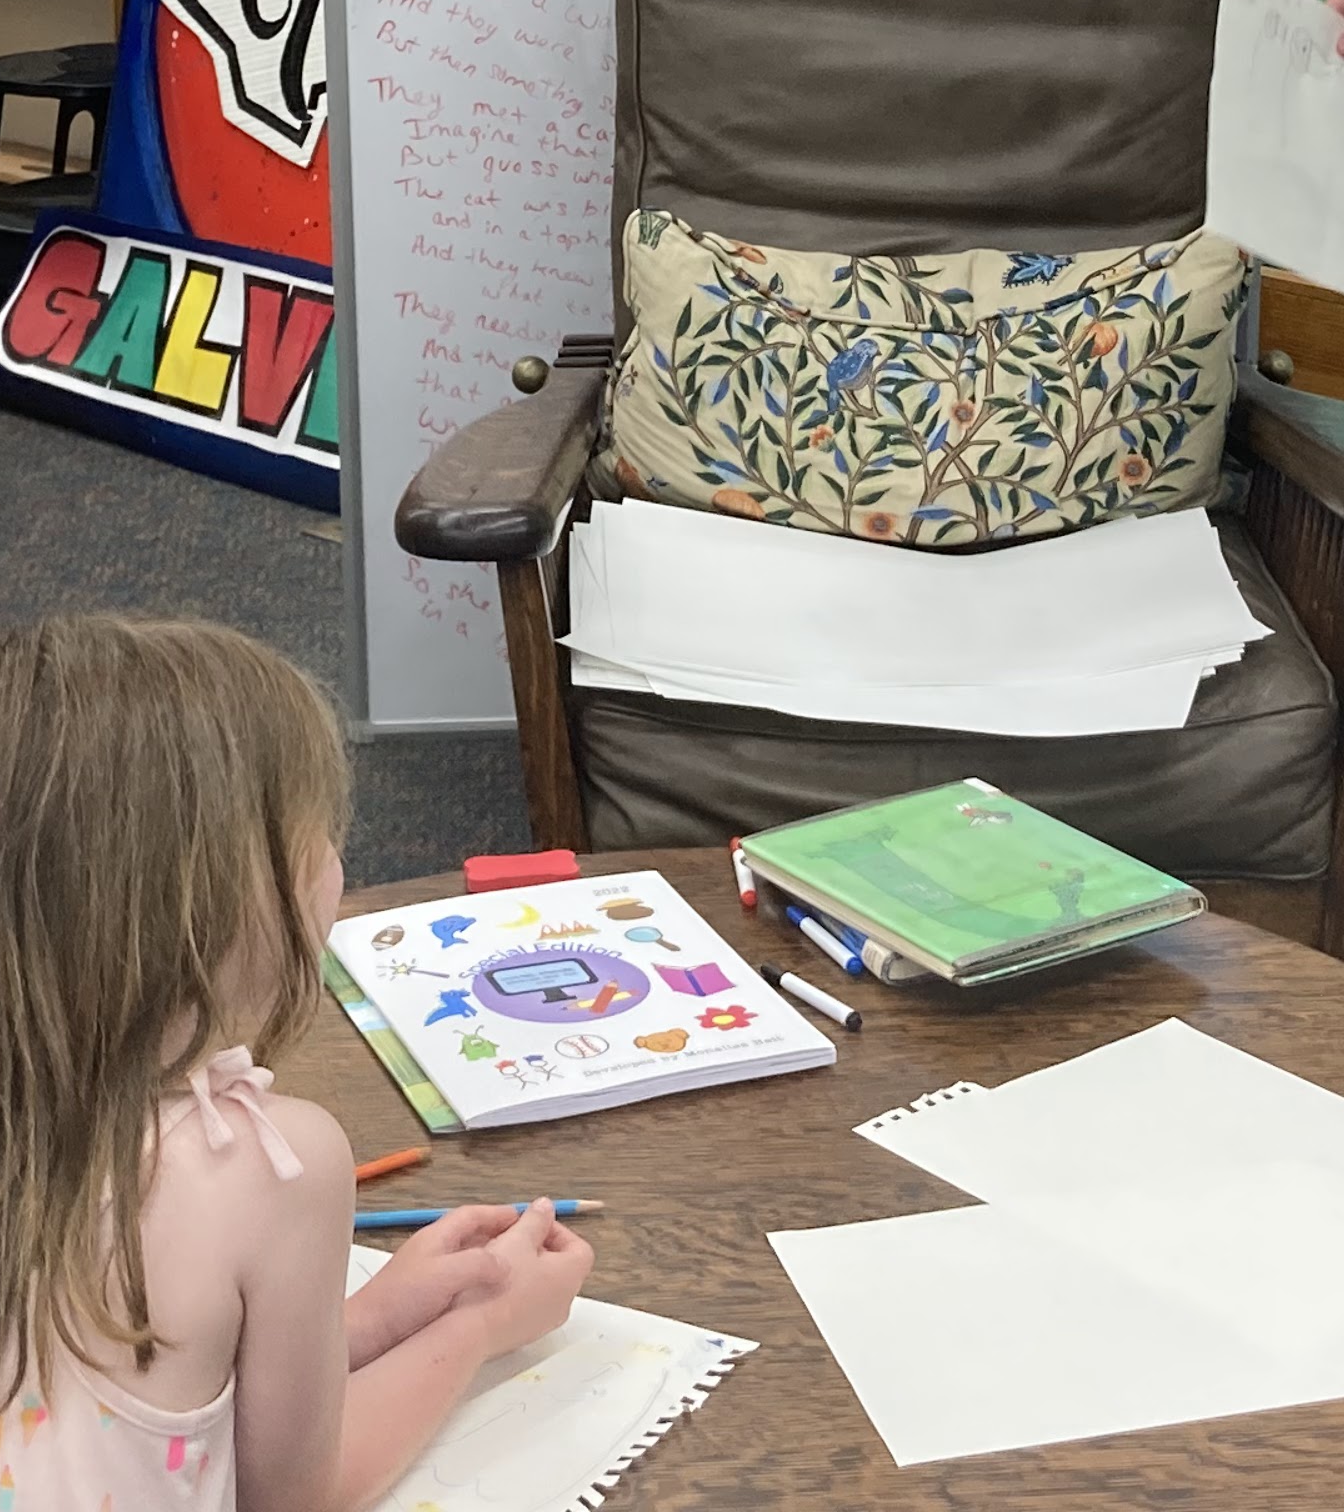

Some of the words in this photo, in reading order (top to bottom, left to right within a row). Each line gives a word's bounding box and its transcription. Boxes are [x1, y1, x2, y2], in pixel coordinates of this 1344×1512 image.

[376, 19, 421, 53] But
[445, 1, 499, 45] they
[366, 74, 445, 120] They
[472, 100, 529, 126] met
[545, 120, 561, 135] a
[402, 117, 522, 155] Imagine
[537, 134, 602, 161] that
[400, 144, 459, 168] But
[572, 168, 614, 187] wha
[393, 176, 447, 202] The
[463, 190, 503, 209] cat
[432, 210, 472, 230] and
[410, 233, 456, 262] And
[421, 337, 464, 364] And
[458, 944, 527, 980] Special
[532, 941, 624, 959] Edition
